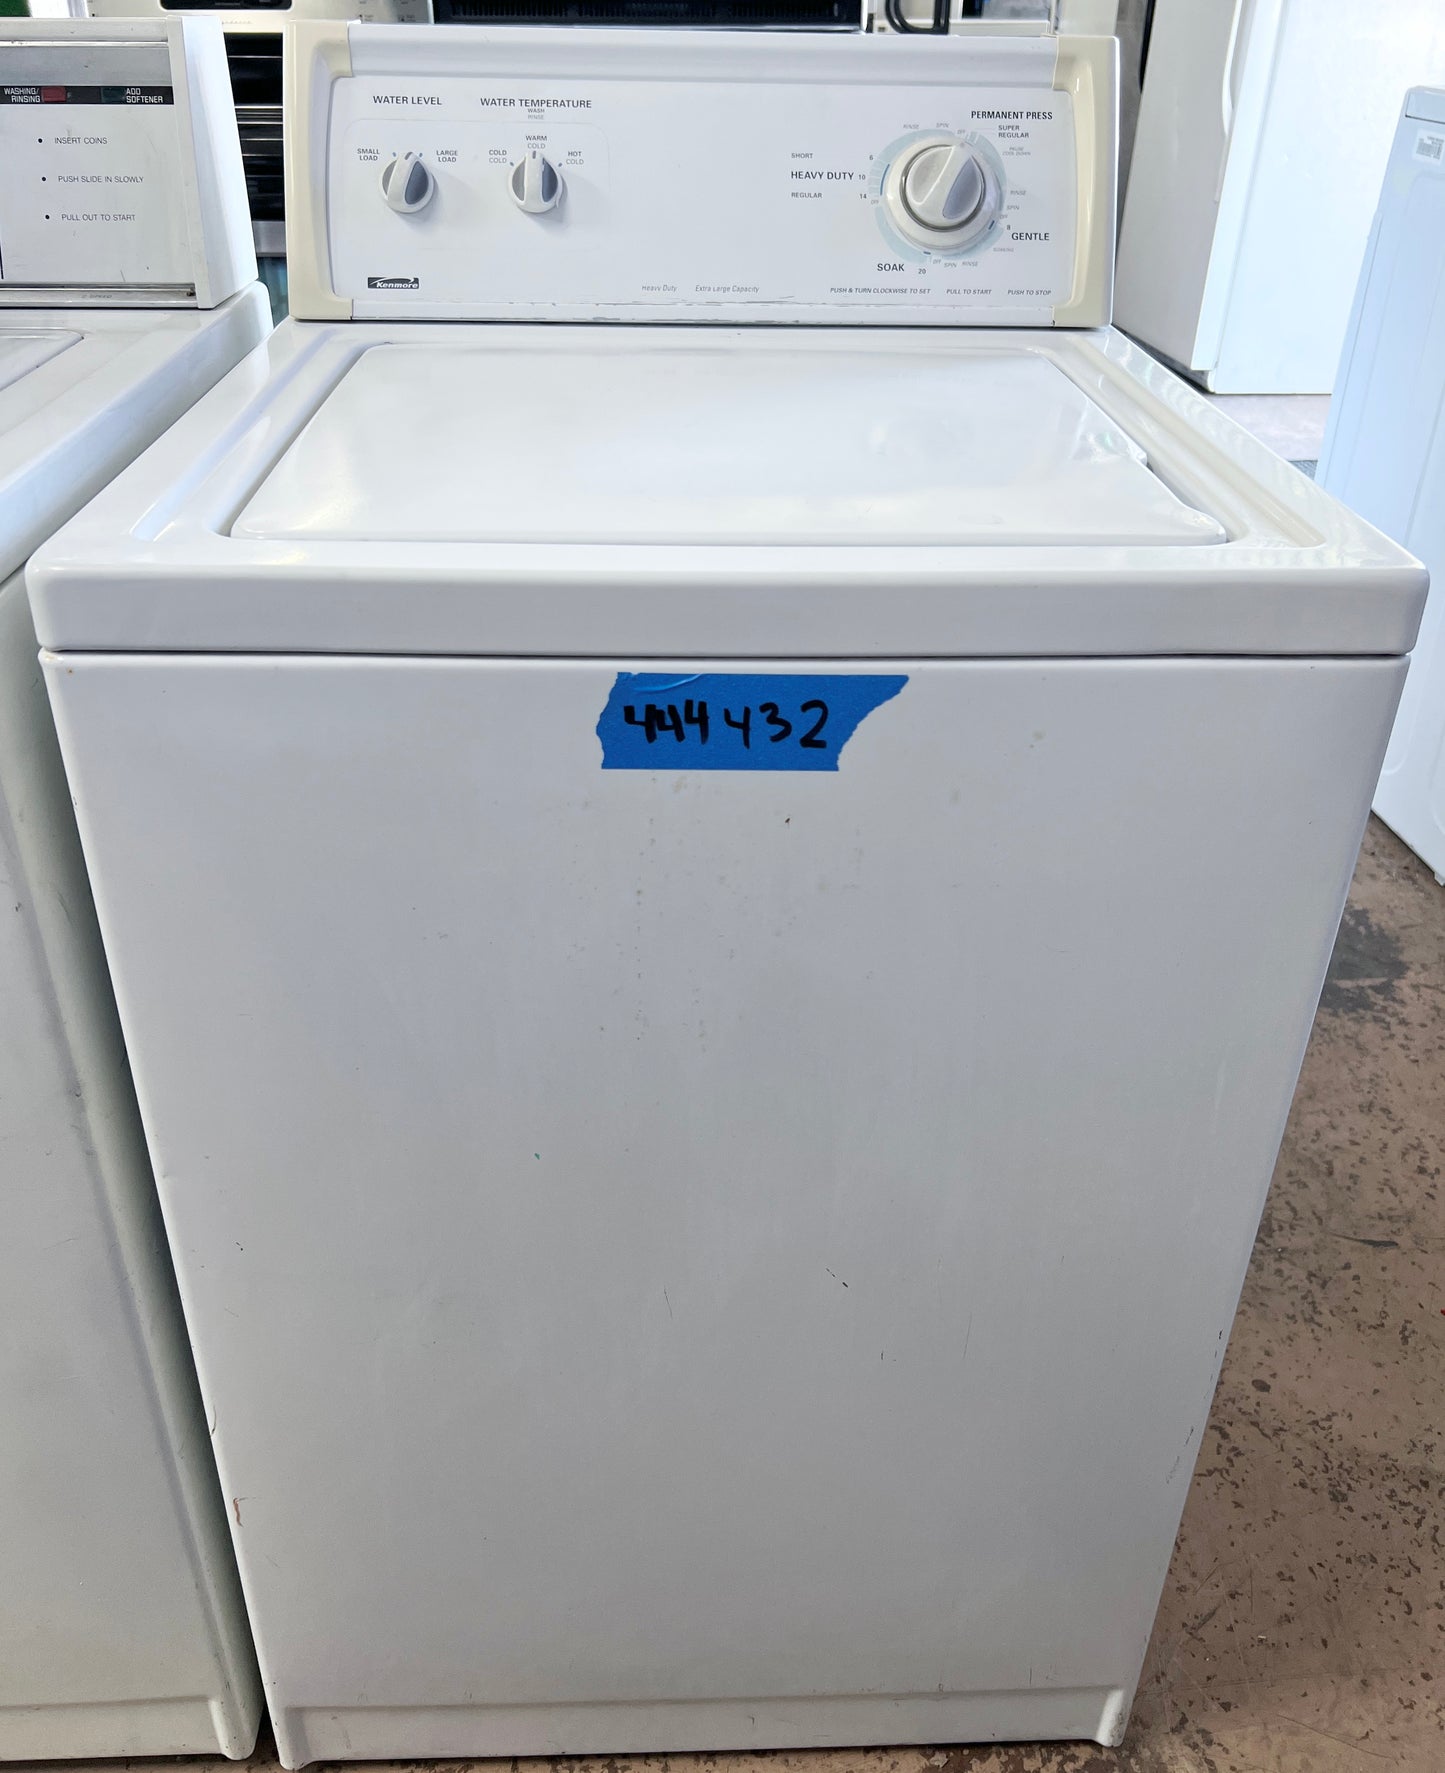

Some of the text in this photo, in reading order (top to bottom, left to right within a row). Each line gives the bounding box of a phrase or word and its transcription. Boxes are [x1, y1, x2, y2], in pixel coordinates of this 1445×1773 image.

[3, 87, 39, 95] WASHING/
[126, 87, 141, 95] ADD
[11, 95, 41, 103] RINSING
[373, 95, 442, 105] WATER LEVEL
[480, 98, 592, 108] WATER TEMPERATURE
[971, 110, 1053, 120] PERMANENT PRESS
[791, 171, 854, 180] HEAVY DUTY
[61, 213, 135, 221] PULL OUT TO START
[1011, 232, 1050, 241] GENTLE
[877, 263, 905, 272] SOAK
[641, 284, 677, 292] Heavy Duty
[695, 284, 760, 293] Extra Large Capacity
